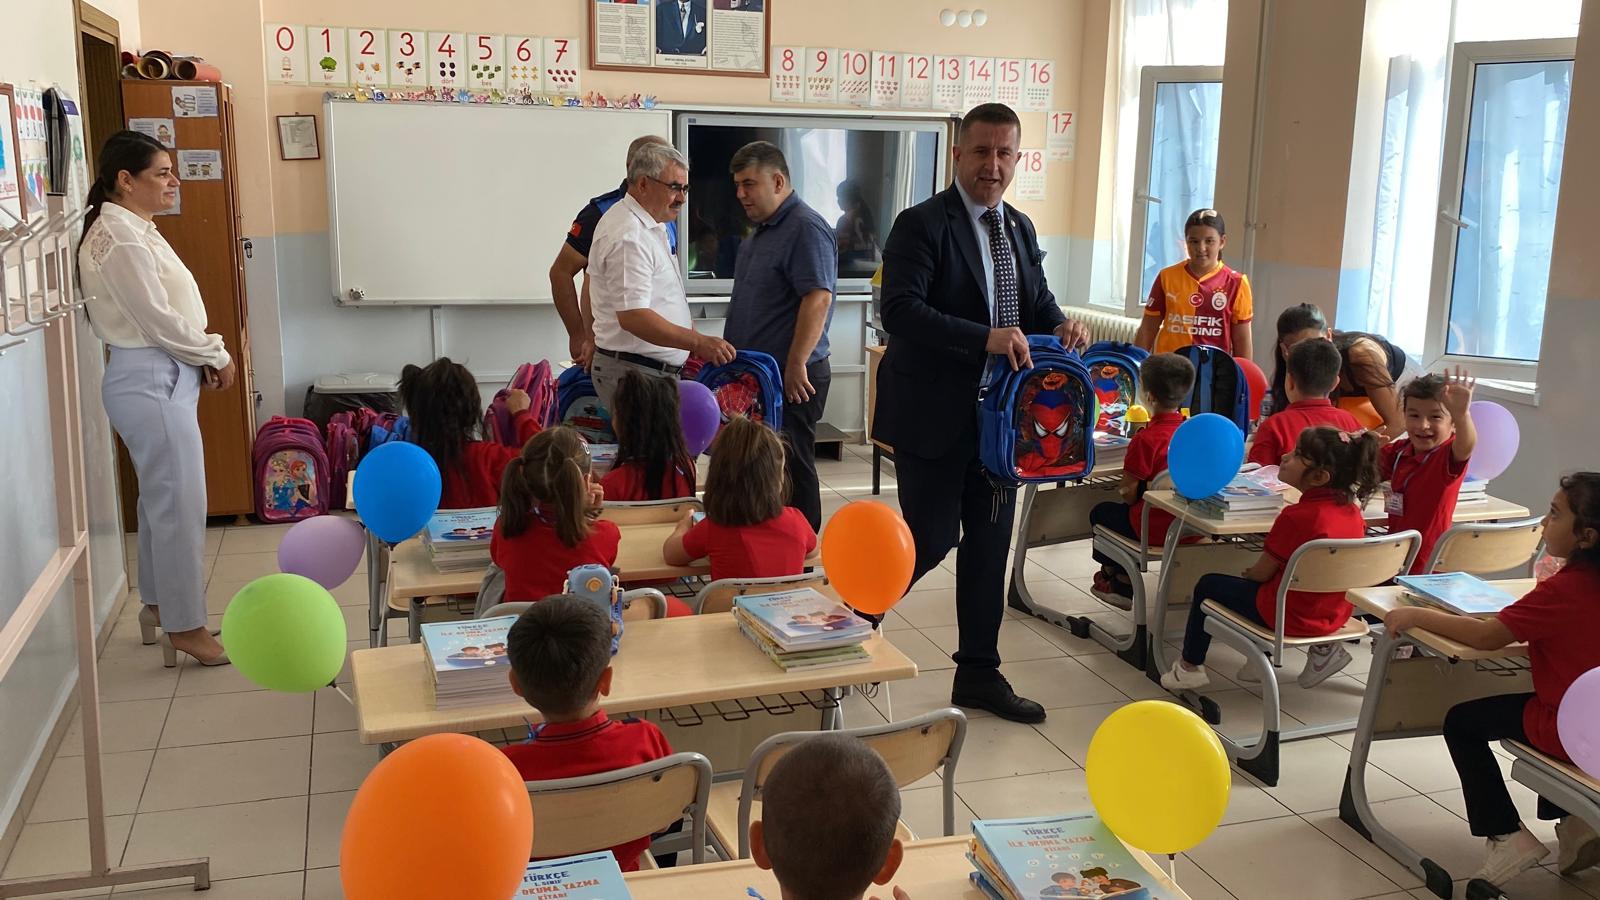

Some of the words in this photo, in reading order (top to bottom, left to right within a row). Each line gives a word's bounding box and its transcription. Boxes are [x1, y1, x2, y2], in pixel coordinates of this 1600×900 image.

[276, 26, 295, 52] 0
[321, 28, 331, 53] 1
[359, 30, 375, 55] 2
[399, 32, 415, 56] 3
[437, 34, 456, 58] 4
[478, 36, 493, 60] 5
[516, 38, 531, 62] 6
[554, 39, 569, 63] 7
[781, 49, 795, 72] 8
[815, 50, 828, 73] 9
[842, 52, 867, 75] 10
[878, 54, 896, 78] 11
[907, 56, 929, 79] 12
[938, 58, 961, 81] 13
[968, 59, 991, 82] 14
[1000, 61, 1020, 83] 15
[1030, 62, 1051, 84] 16
[1052, 112, 1073, 134] 17
[1022, 151, 1042, 172] 18
[1022, 826, 1065, 836] TÜRKÇE
[1062, 834, 1096, 844] YAZMA
[521, 885, 560, 896] OKUMA
[562, 879, 600, 890] YAZMA
[523, 871, 569, 882] TÜRKÇE
